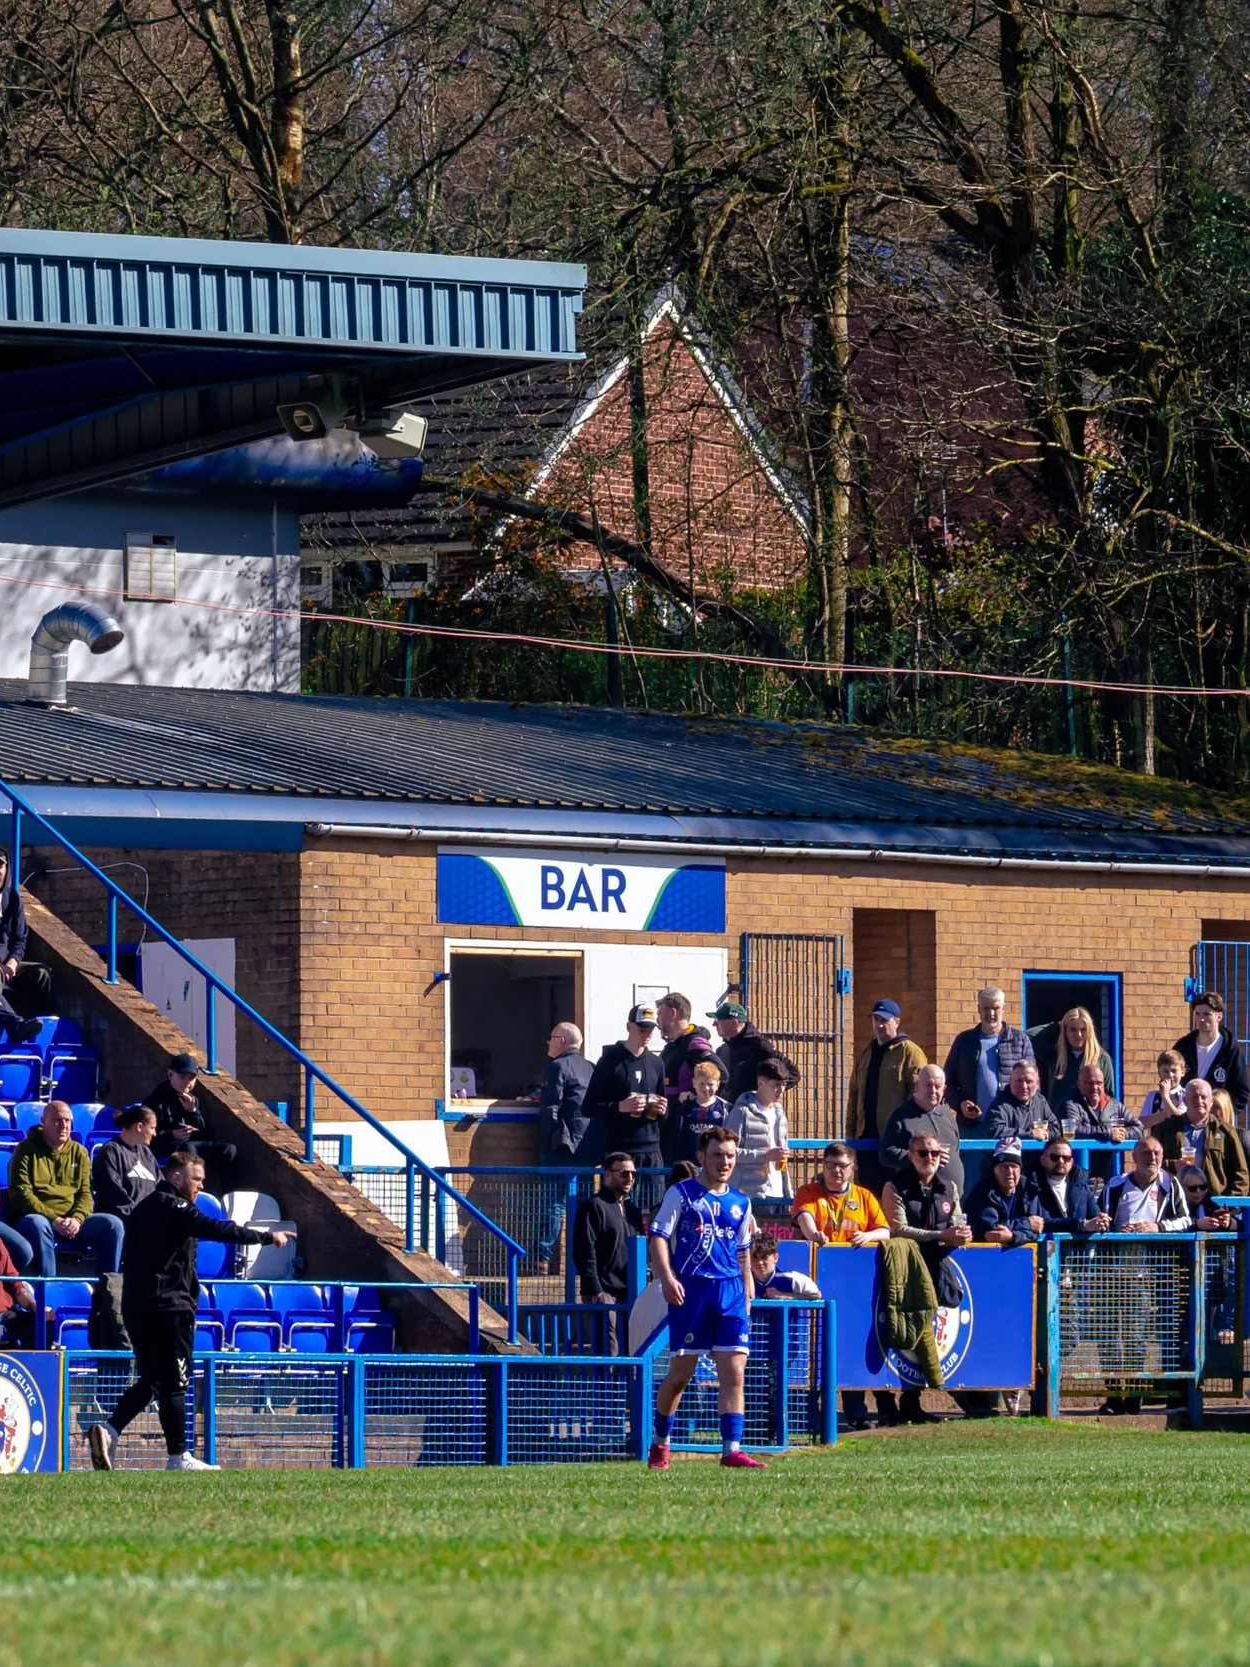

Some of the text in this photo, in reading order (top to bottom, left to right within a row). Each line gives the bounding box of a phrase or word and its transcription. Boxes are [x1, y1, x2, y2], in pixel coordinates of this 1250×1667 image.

[541, 865, 627, 913] BAR
[890, 1353, 926, 1381] FOOTBA
[9, 1368, 37, 1407] CELTIC
